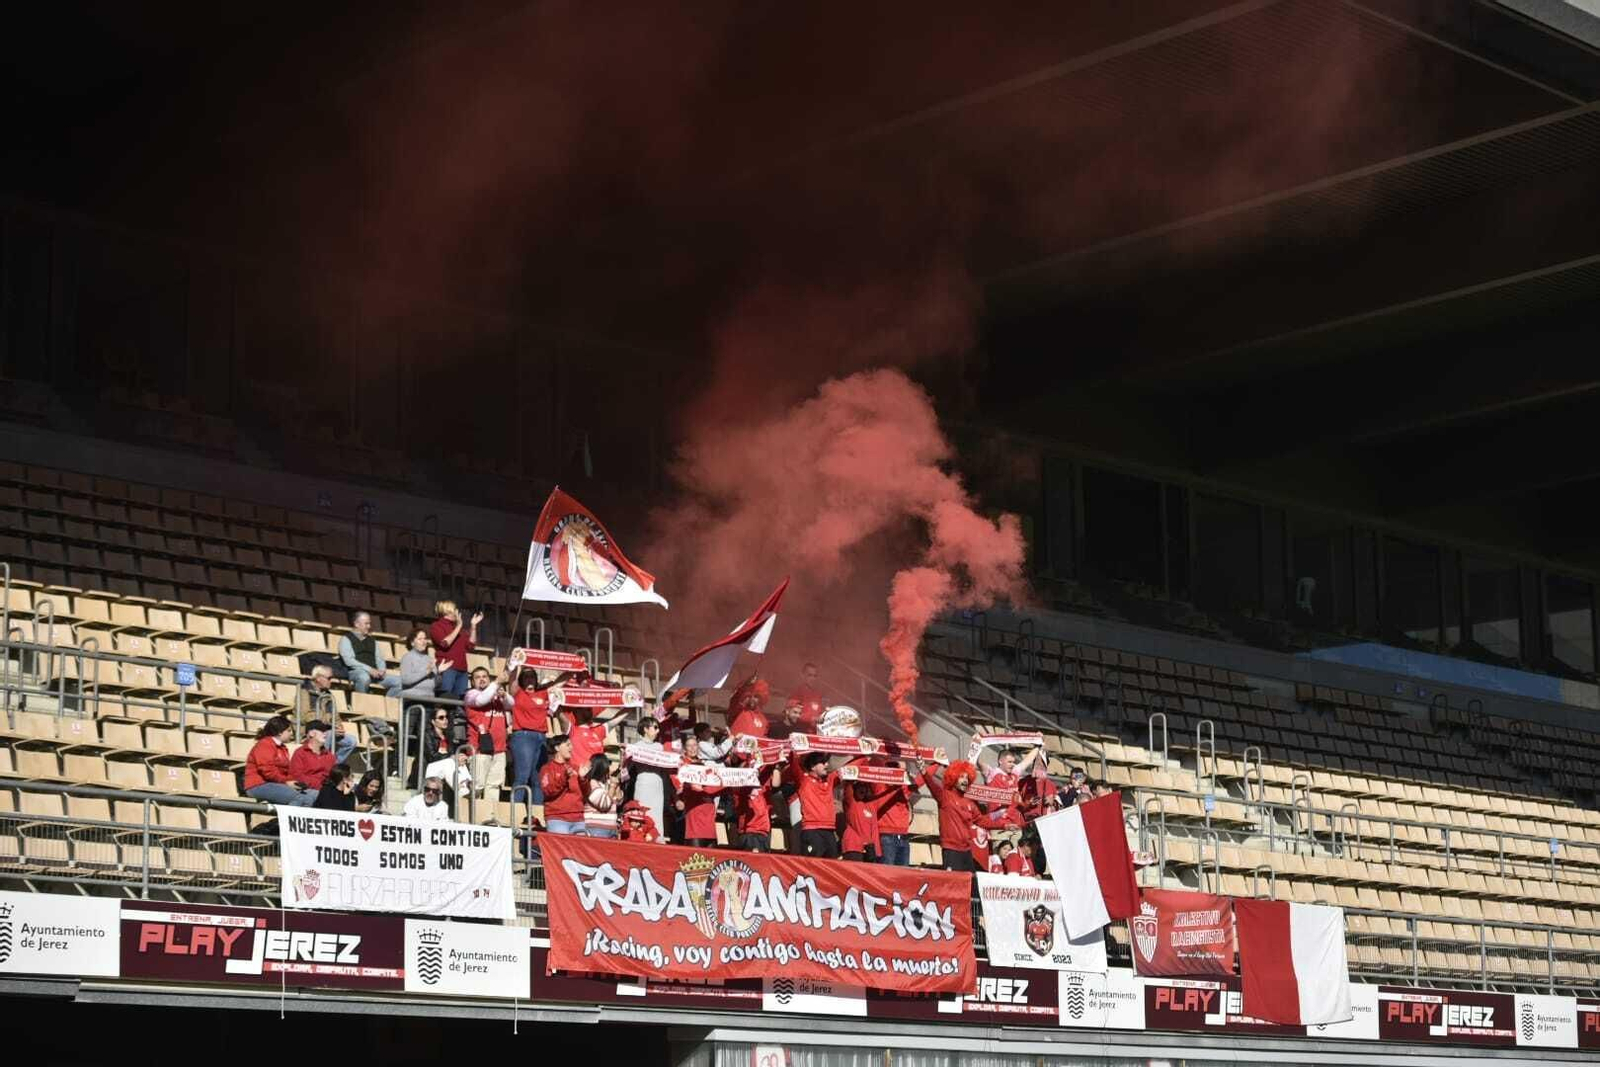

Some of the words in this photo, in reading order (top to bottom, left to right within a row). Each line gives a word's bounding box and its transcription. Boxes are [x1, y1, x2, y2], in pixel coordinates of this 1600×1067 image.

[288, 816, 356, 838] NUESTROS
[381, 824, 422, 845] ESTÁN
[430, 828, 490, 848] CONTIGO
[316, 846, 358, 867] TODOS
[380, 852, 426, 870] SOMOS
[440, 854, 464, 870] UNO
[561, 858, 698, 923] GRADA
[20, 922, 105, 938] Ayuntamiento
[20, 938, 35, 948] de
[38, 938, 68, 951] Jerez
[138, 923, 245, 957] PLAY
[450, 949, 518, 962] Ayuntamiento
[673, 944, 712, 970] voy
[720, 937, 800, 964] contigo
[804, 942, 859, 970] hasta
[861, 949, 888, 972] la
[449, 962, 460, 971] de
[463, 964, 488, 974] Jerez
[799, 984, 809, 992] de
[811, 984, 832, 994] Jerez
[1089, 988, 1136, 1000] Ayuntamiento
[1099, 999, 1116, 1009] Jerez
[1155, 988, 1214, 1012] PLAY
[1388, 1002, 1438, 1024] PLAY
[1538, 1014, 1572, 1023] Ayuntamiento
